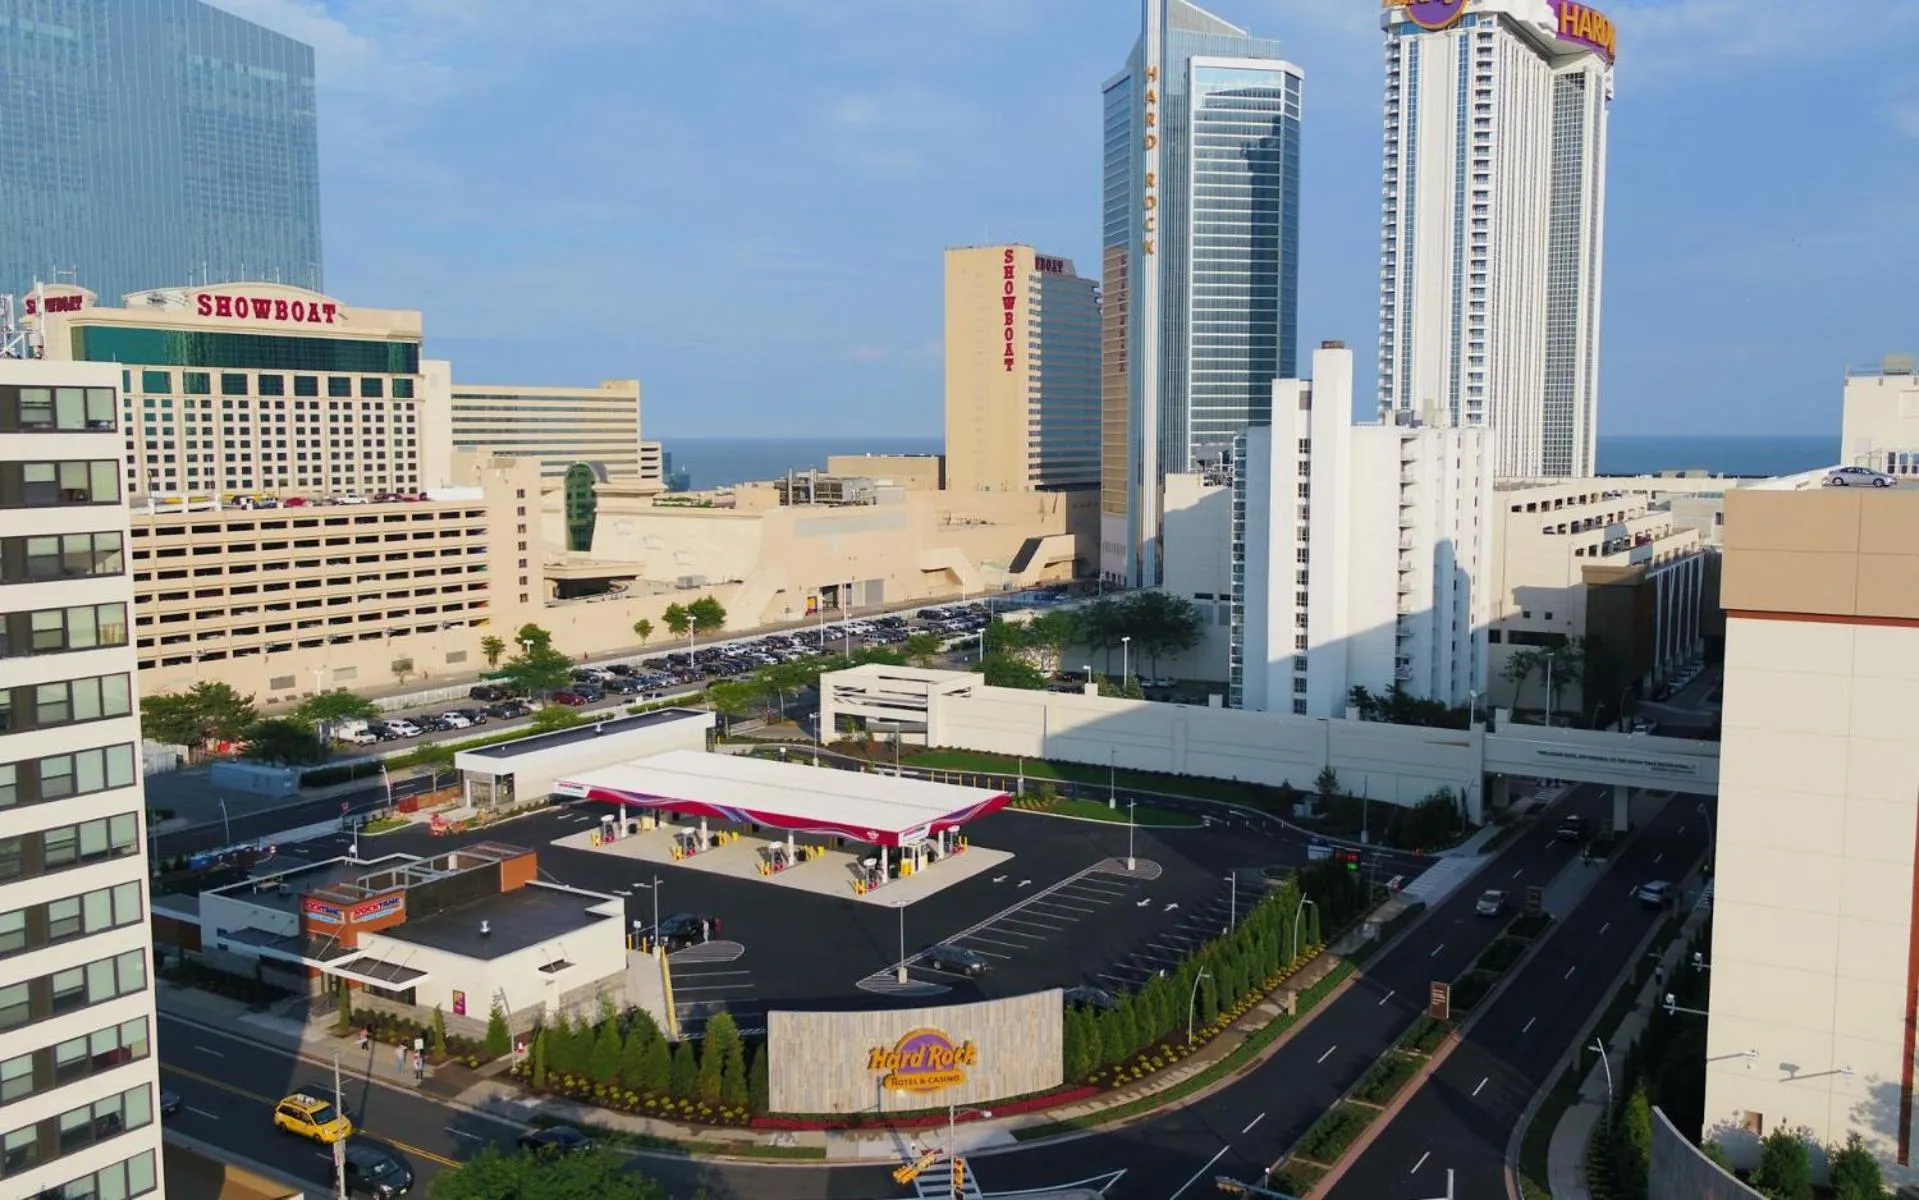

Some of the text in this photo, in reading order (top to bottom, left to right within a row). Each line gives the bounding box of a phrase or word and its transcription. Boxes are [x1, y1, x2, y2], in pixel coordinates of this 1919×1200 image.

[1144, 65, 1157, 255] HARD ROCK
[197, 294, 336, 323] SHOWBOAT
[1002, 249, 1016, 371] SHOWBOAT
[867, 1040, 977, 1070] Hard Rock
[891, 1077, 917, 1086] HOTEL
[928, 1075, 960, 1083] CASINO
